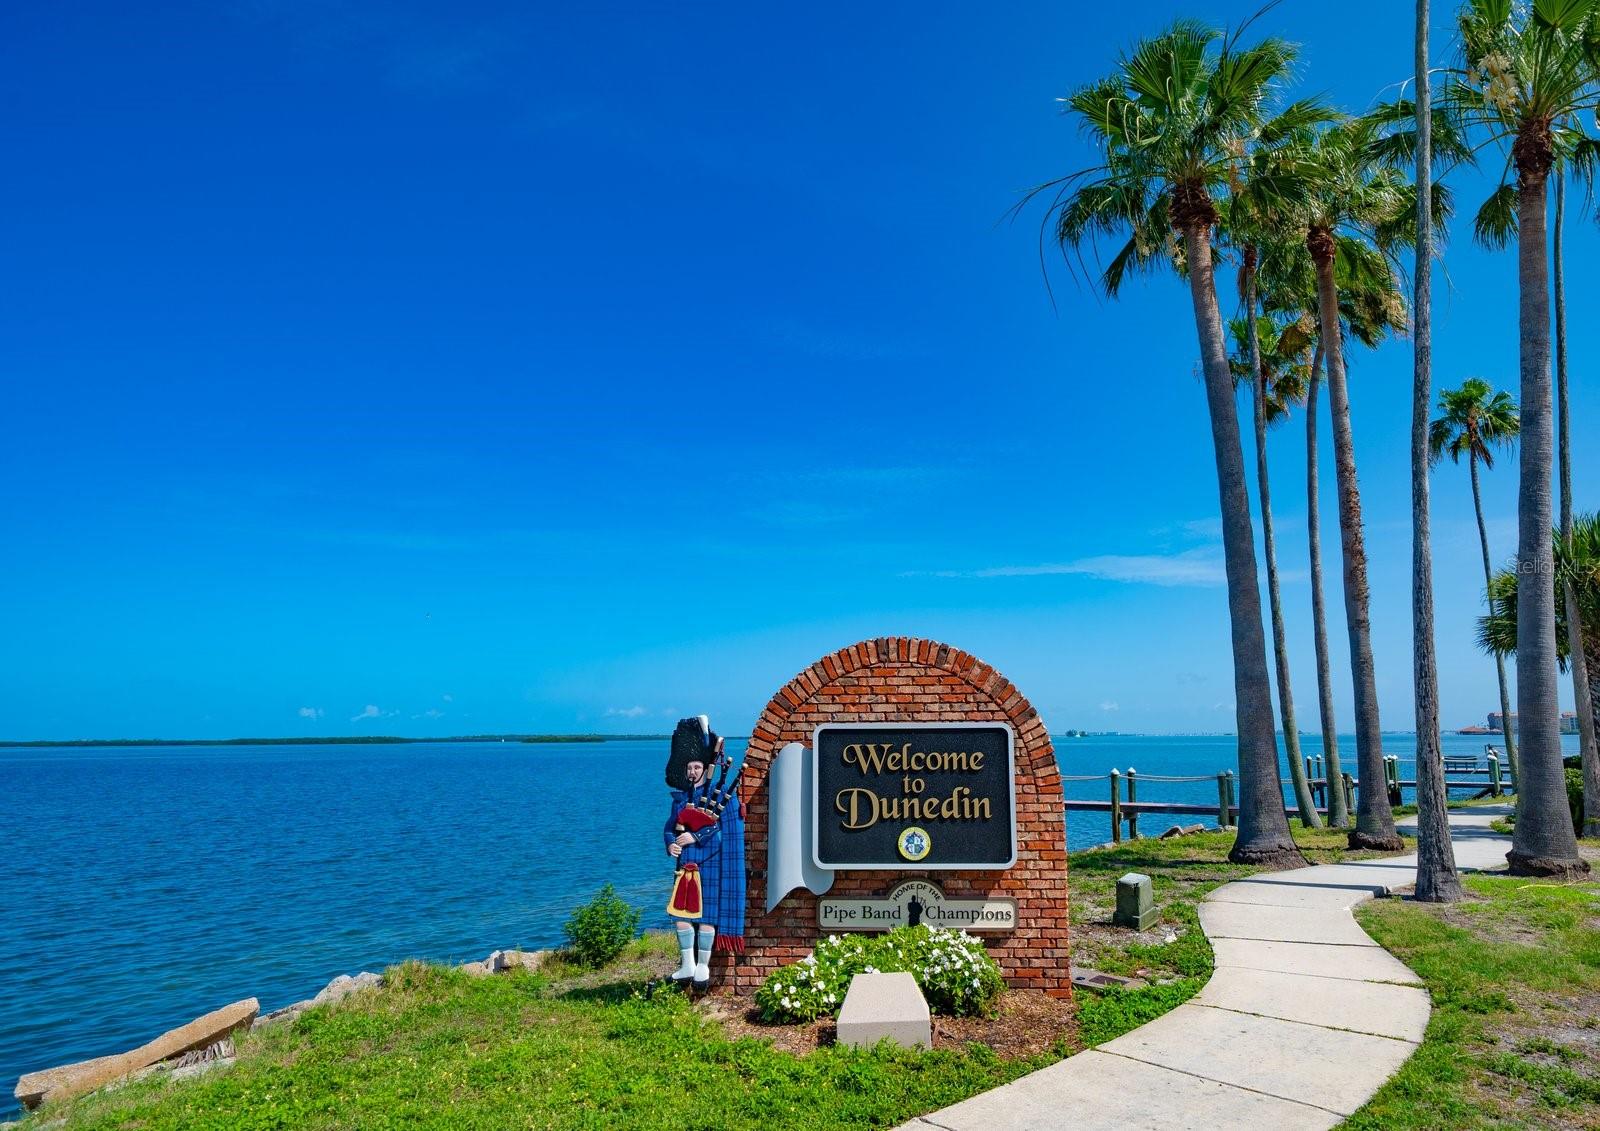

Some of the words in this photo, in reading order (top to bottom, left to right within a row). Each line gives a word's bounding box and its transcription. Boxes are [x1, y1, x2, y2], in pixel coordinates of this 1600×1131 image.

[843, 743, 984, 775] Welcome
[903, 774, 925, 793] to
[836, 787, 992, 829] Dunedin
[892, 883, 915, 901] HOME
[928, 888, 941, 901] THE
[823, 905, 857, 923] Pipe
[862, 905, 901, 920] Band
[925, 905, 1012, 923] Champions
